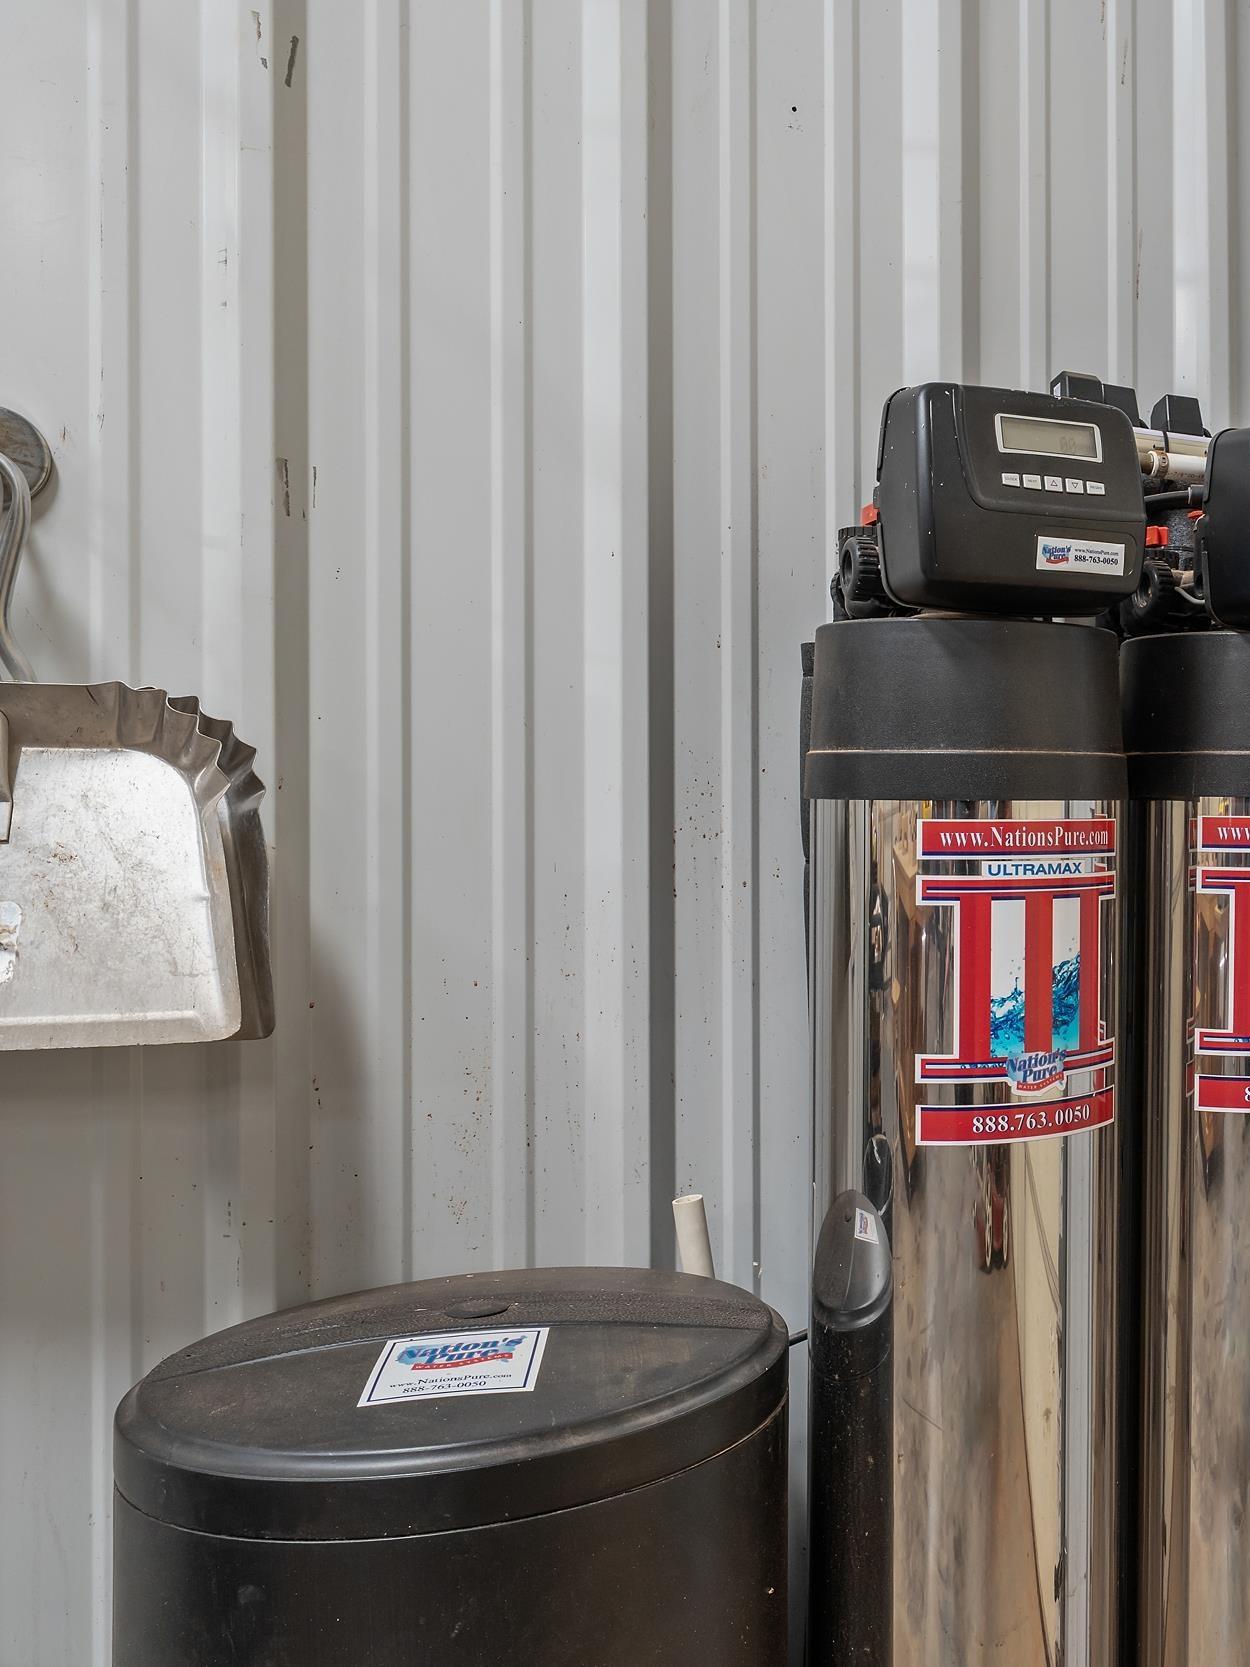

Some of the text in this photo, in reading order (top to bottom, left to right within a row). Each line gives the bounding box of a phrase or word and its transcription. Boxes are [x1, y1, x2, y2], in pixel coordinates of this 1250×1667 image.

[1074, 554, 1119, 565] 888-763-0050
[940, 826, 1109, 847] www.NationsPure.com
[988, 862, 1082, 876] ULTRAMAX
[1007, 1048, 1067, 1072] Nation's
[1022, 1066, 1058, 1083] Pure
[972, 1104, 1091, 1133] 888.763.0050
[397, 1336, 525, 1359] Nation's
[424, 1348, 500, 1364] Pure
[389, 1373, 512, 1388] www.NationsPure.com
[402, 1380, 487, 1394] 888-763-0050
